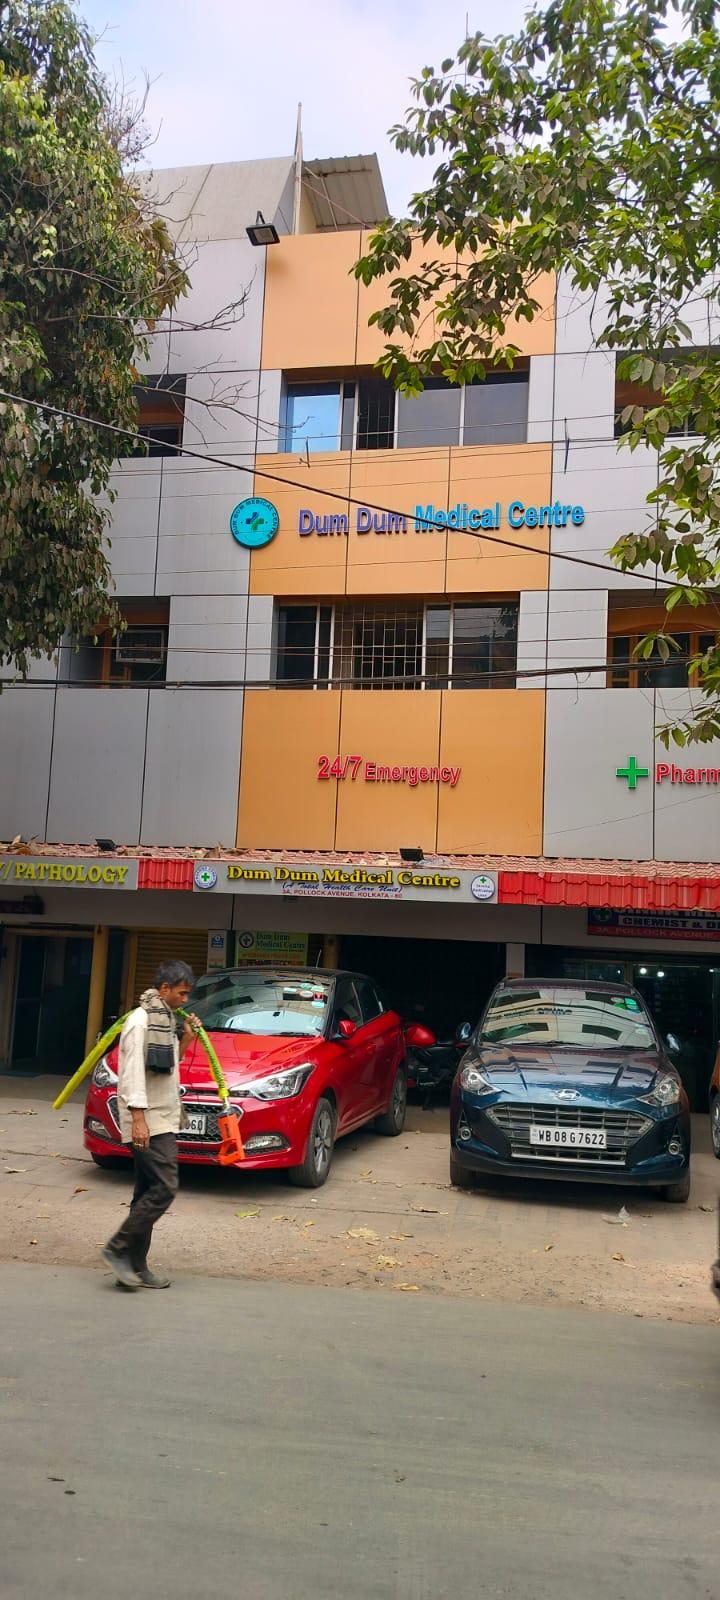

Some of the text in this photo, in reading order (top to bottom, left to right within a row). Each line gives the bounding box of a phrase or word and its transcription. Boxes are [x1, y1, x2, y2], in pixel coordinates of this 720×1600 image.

[299, 501, 585, 535] Dum Dum Medical Centre
[317, 755, 461, 787] 24/7 Emergency
[228, 865, 271, 880] Dum
[274, 867, 318, 882] Dum
[322, 868, 393, 884] Medical
[397, 871, 461, 887] Centre
[623, 917, 689, 928] CHEMIST
[538, 1130, 552, 1143] WB
[554, 1131, 568, 1143] 08
[569, 1132, 576, 1144] G
[578, 1132, 605, 1146] 7622
